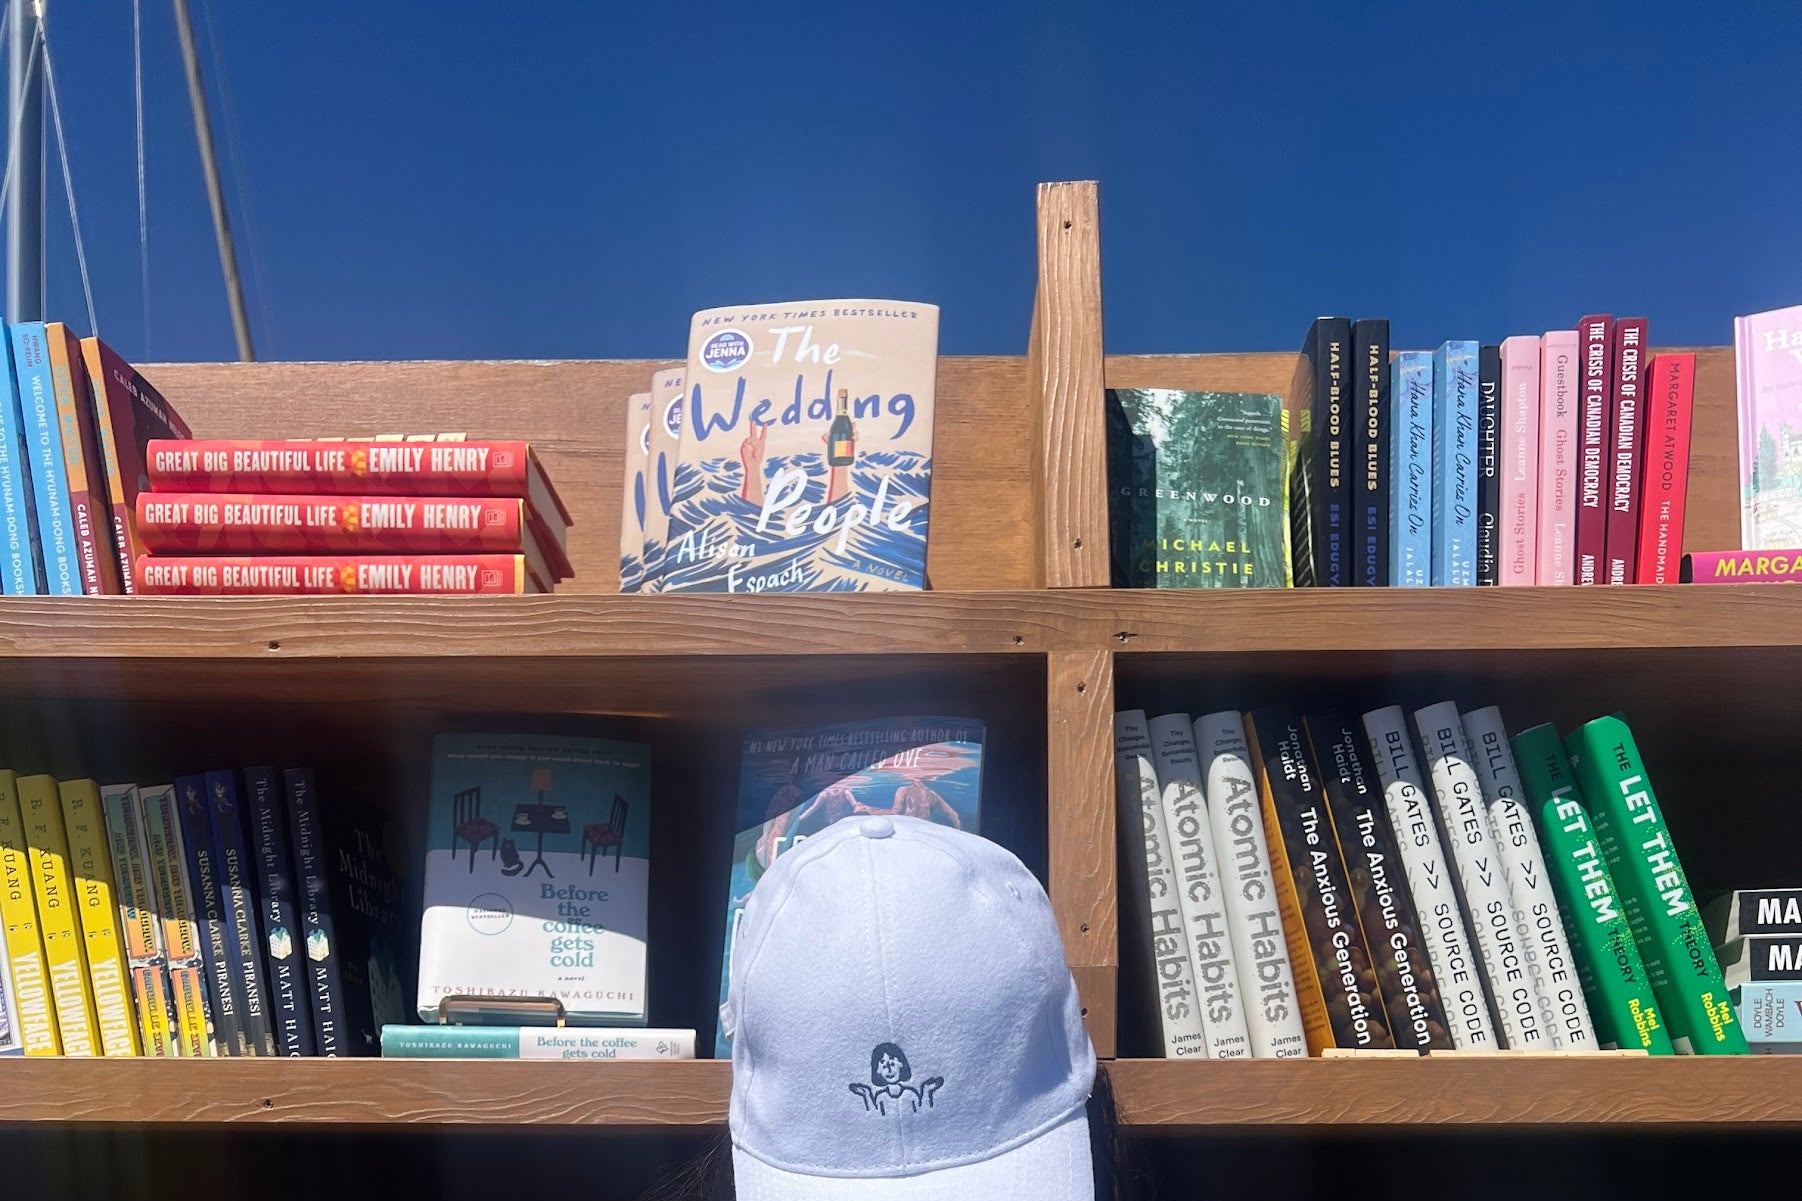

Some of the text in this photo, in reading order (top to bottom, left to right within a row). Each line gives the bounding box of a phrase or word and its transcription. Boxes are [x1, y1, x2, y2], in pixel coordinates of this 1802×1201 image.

[702, 310, 918, 326] NEW YORK TIMES BESTSELLER
[32, 335, 41, 364] HWANG
[705, 346, 746, 359] JENNA
[710, 340, 727, 349] READ
[768, 325, 841, 364] The
[691, 368, 915, 442] Weddng
[1368, 345, 1378, 491] HALF-BLOOD BLUES
[1615, 327, 1639, 512] THE CRISIS OF CANADIAN DEMOCRACY
[1455, 370, 1472, 525] Hana Khan Carries On
[1555, 355, 1569, 512] Guestbook Ghost Stories
[1660, 363, 1679, 521] MARGARET ATWOOD THE
[31, 376, 66, 552] WELCOME TO THE HYUNAM-DONG
[156, 448, 489, 472] GREAT BIG BEAUTIFUL LIFE EMILY HENRY
[756, 467, 913, 556] People
[1121, 487, 1271, 507] GREENWOOD
[77, 504, 97, 584] CALEB AZUMAH
[676, 530, 756, 564] Alison
[1144, 539, 1251, 553] MICHAEL
[853, 560, 910, 583] A NOVEL
[1139, 561, 1254, 575] CHRISTIE
[791, 748, 922, 775] A MAN CALLED OVE
[1612, 743, 1709, 978] THE LET THEM THEORY
[40, 848, 60, 909] KUANG
[540, 883, 608, 902] Before
[1385, 730, 1486, 1045] BILL GATES SOURCE CODE
[557, 903, 590, 916] the
[1221, 776, 1289, 1024] Atomic Habits
[227, 848, 260, 1017] SUSANNA CLARKE PIRANESI
[542, 917, 605, 934] coffee
[1356, 809, 1432, 1046] The Anxious Generation
[550, 937, 594, 953] gets
[550, 952, 594, 967] cold
[13, 952, 52, 1053] YELLOWFACE
[278, 966, 294, 1011] MATT
[538, 989, 635, 1001] KAWAGUCHI
[1701, 992, 1725, 1041] Robbins
[1717, 1000, 1734, 1024] Mel
[1765, 988, 1773, 1037] WAMBACH
[537, 1036, 637, 1048] Before the coffee
[1271, 1034, 1302, 1046] James
[1276, 1046, 1302, 1058] Clear
